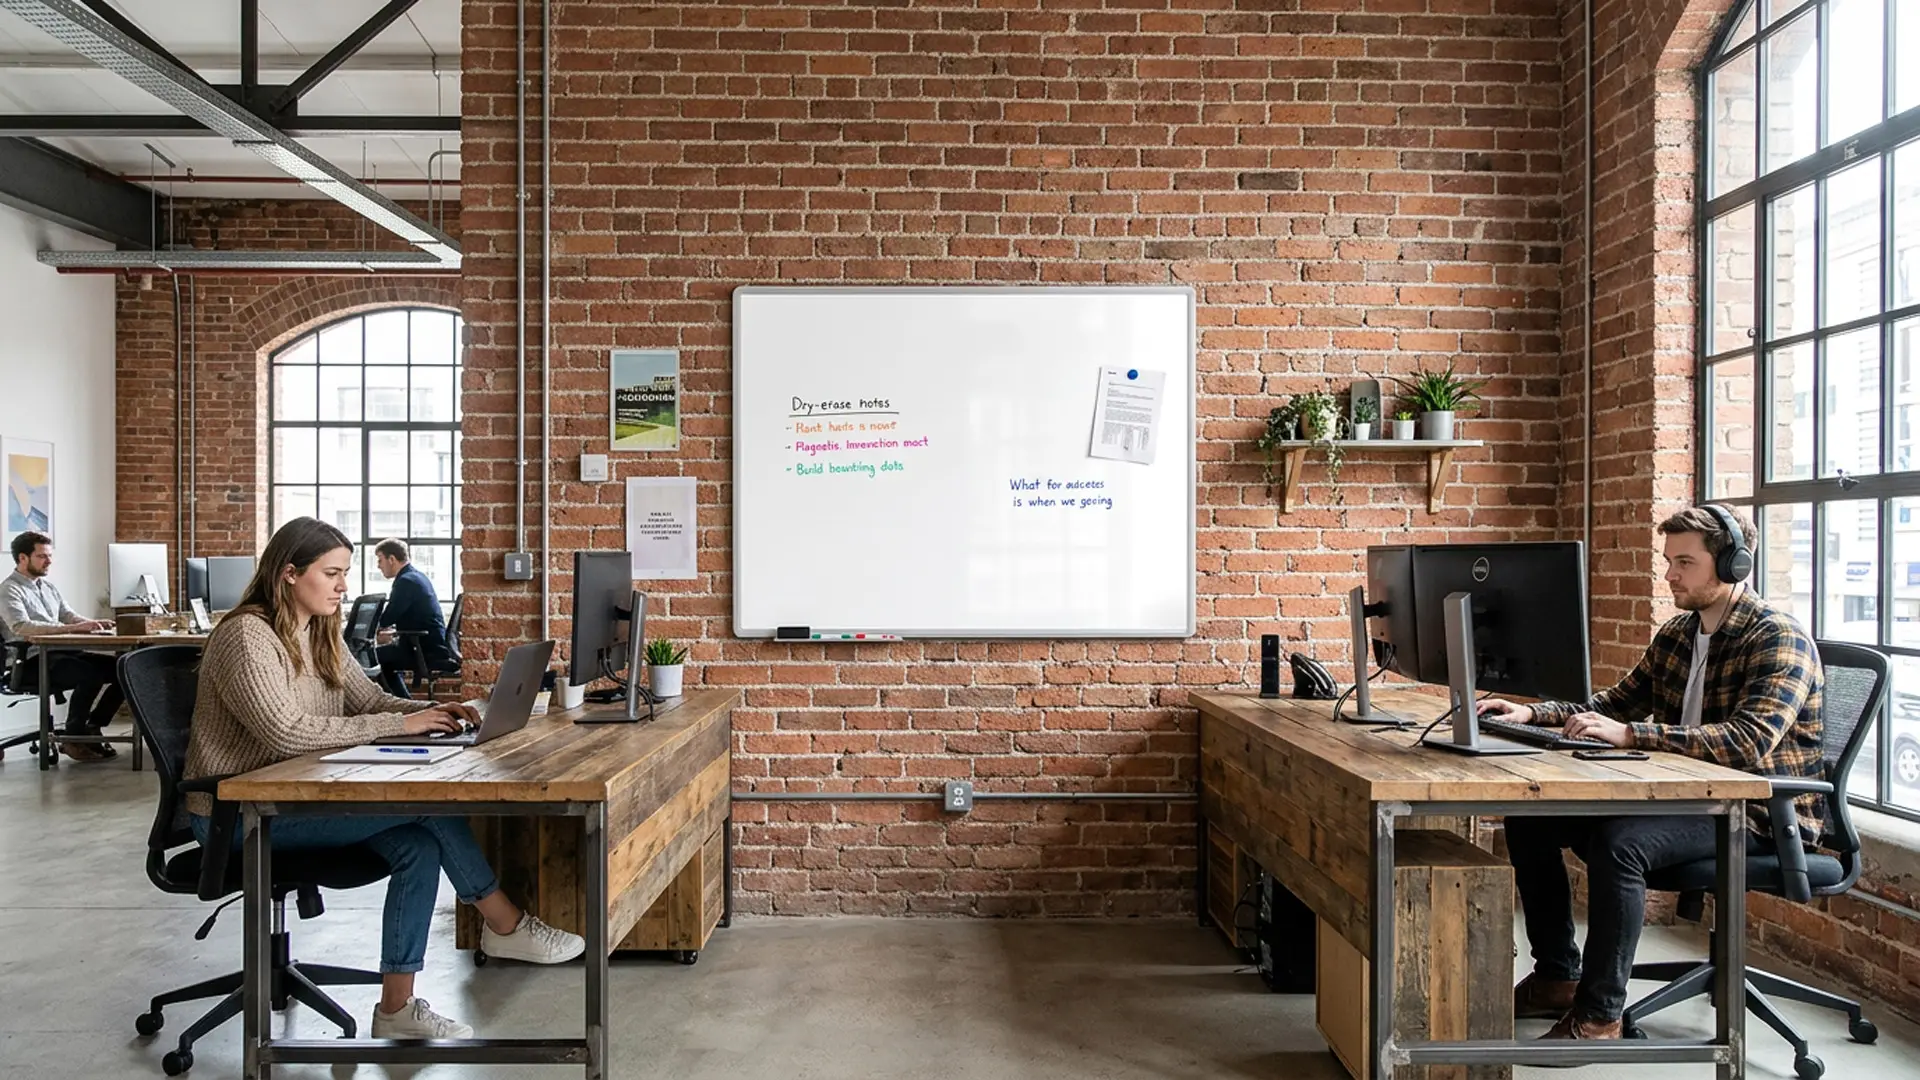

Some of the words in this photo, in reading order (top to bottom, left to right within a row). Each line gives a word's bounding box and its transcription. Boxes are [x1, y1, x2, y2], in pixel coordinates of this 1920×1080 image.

[791, 395, 852, 414] Dry-erase
[1009, 477, 1041, 492] What
[1046, 478, 1063, 491] for
[1012, 496, 1023, 508] is
[1027, 495, 1057, 508] when
[1060, 498, 1076, 507] we
